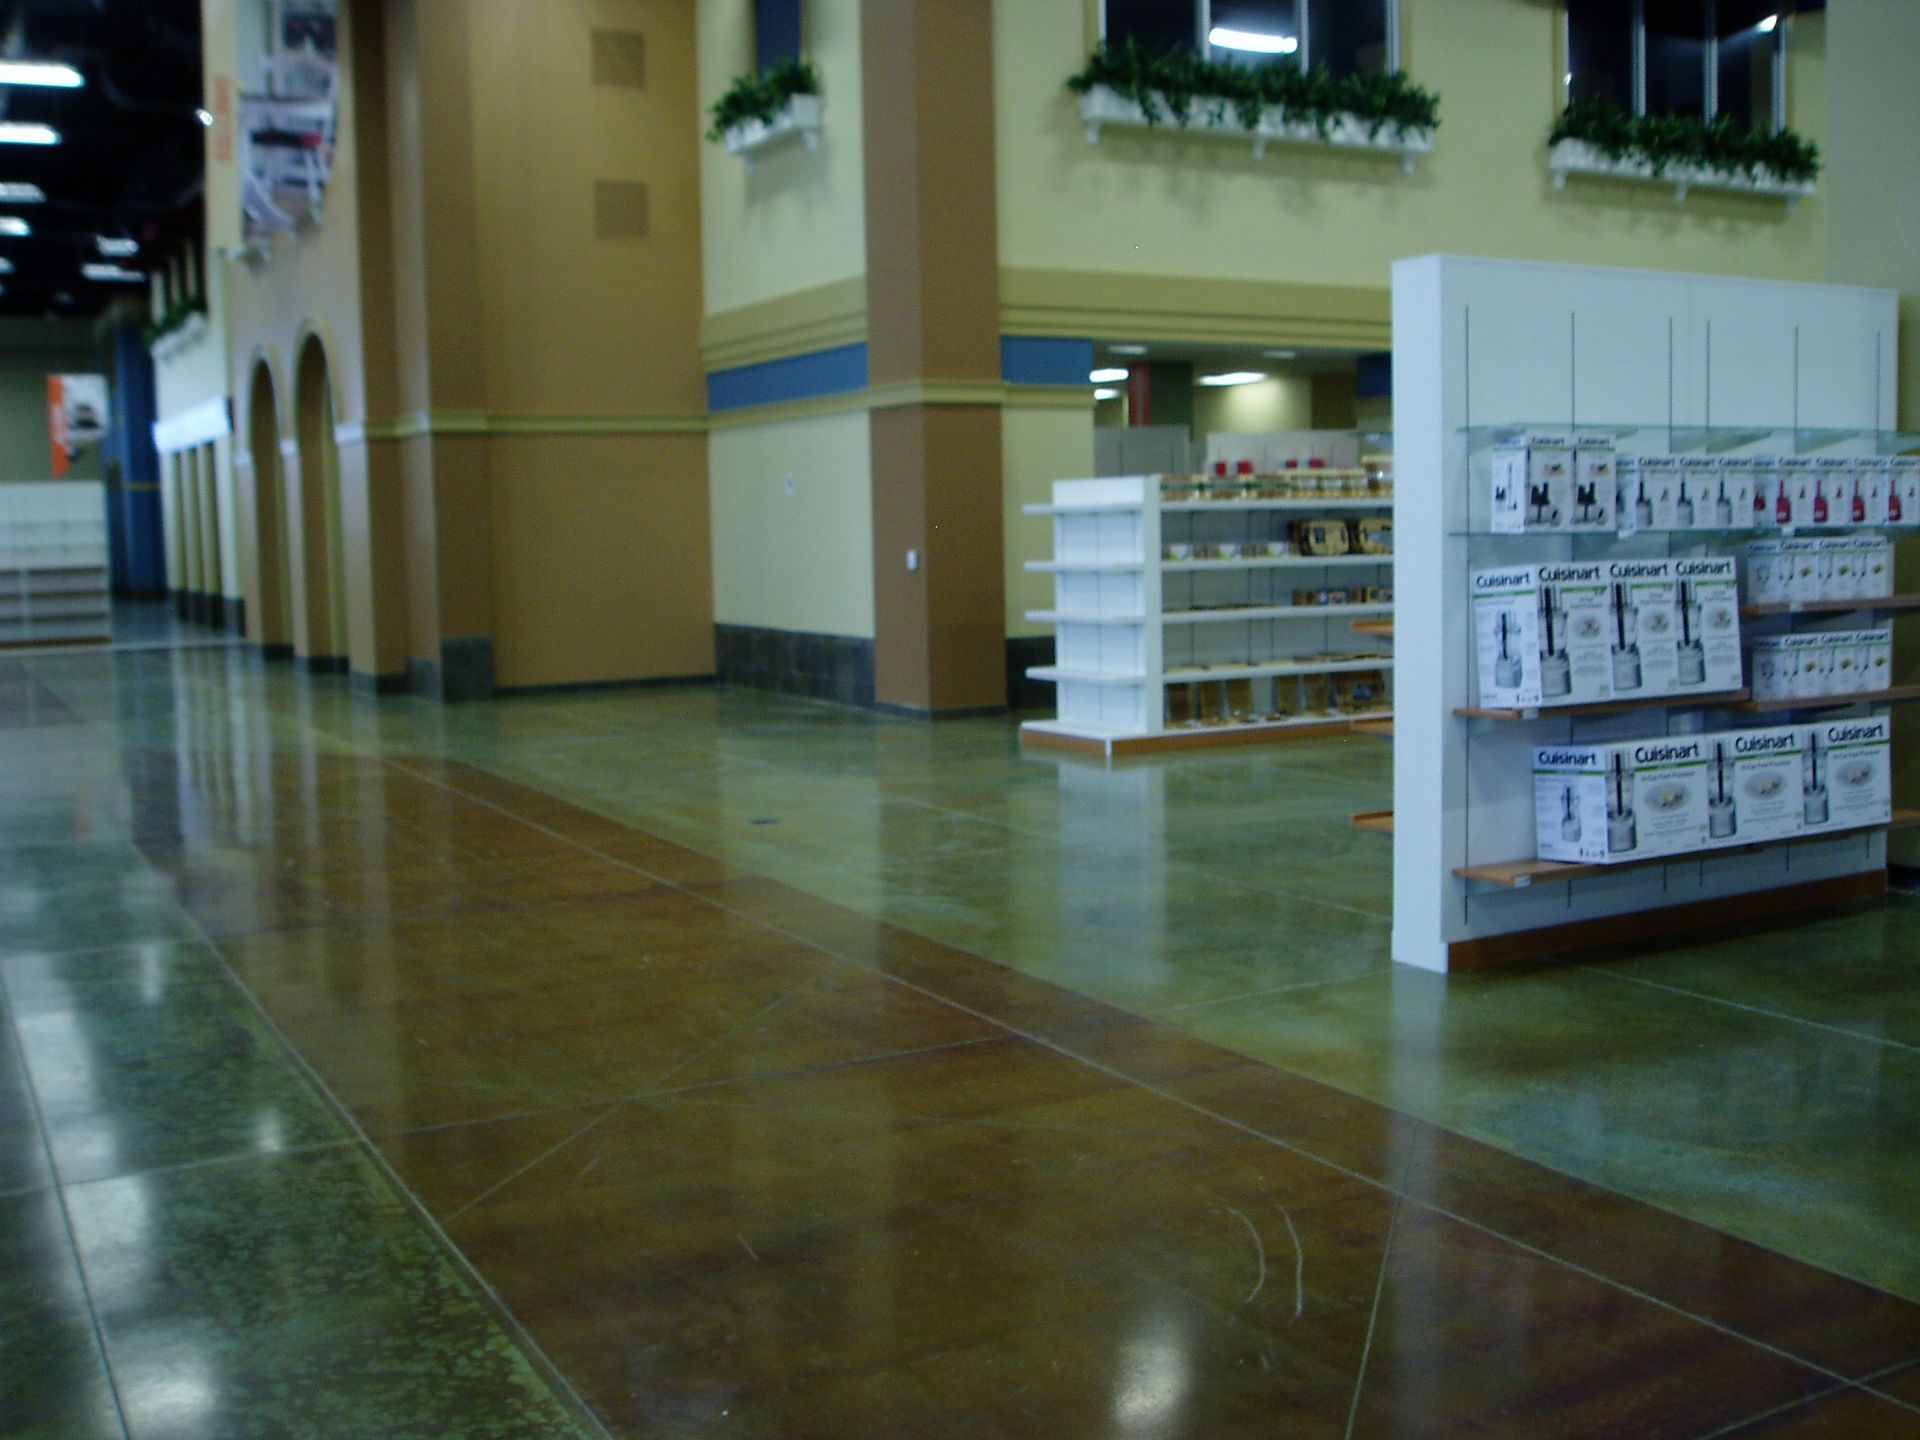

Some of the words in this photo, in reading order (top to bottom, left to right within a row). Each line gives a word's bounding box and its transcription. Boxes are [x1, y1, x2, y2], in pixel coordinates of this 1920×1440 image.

[1539, 566, 1600, 582] Cuisinart
[1610, 562, 1670, 578] Cuisinart
[1676, 560, 1732, 577] Cuisinart
[1476, 572, 1531, 588] Cuisinart
[1828, 723, 1883, 743] Cuisinart
[1735, 733, 1795, 752] Cuisinart
[1538, 751, 1597, 765] Cuisinart
[1635, 742, 1699, 763] Cuisinart
